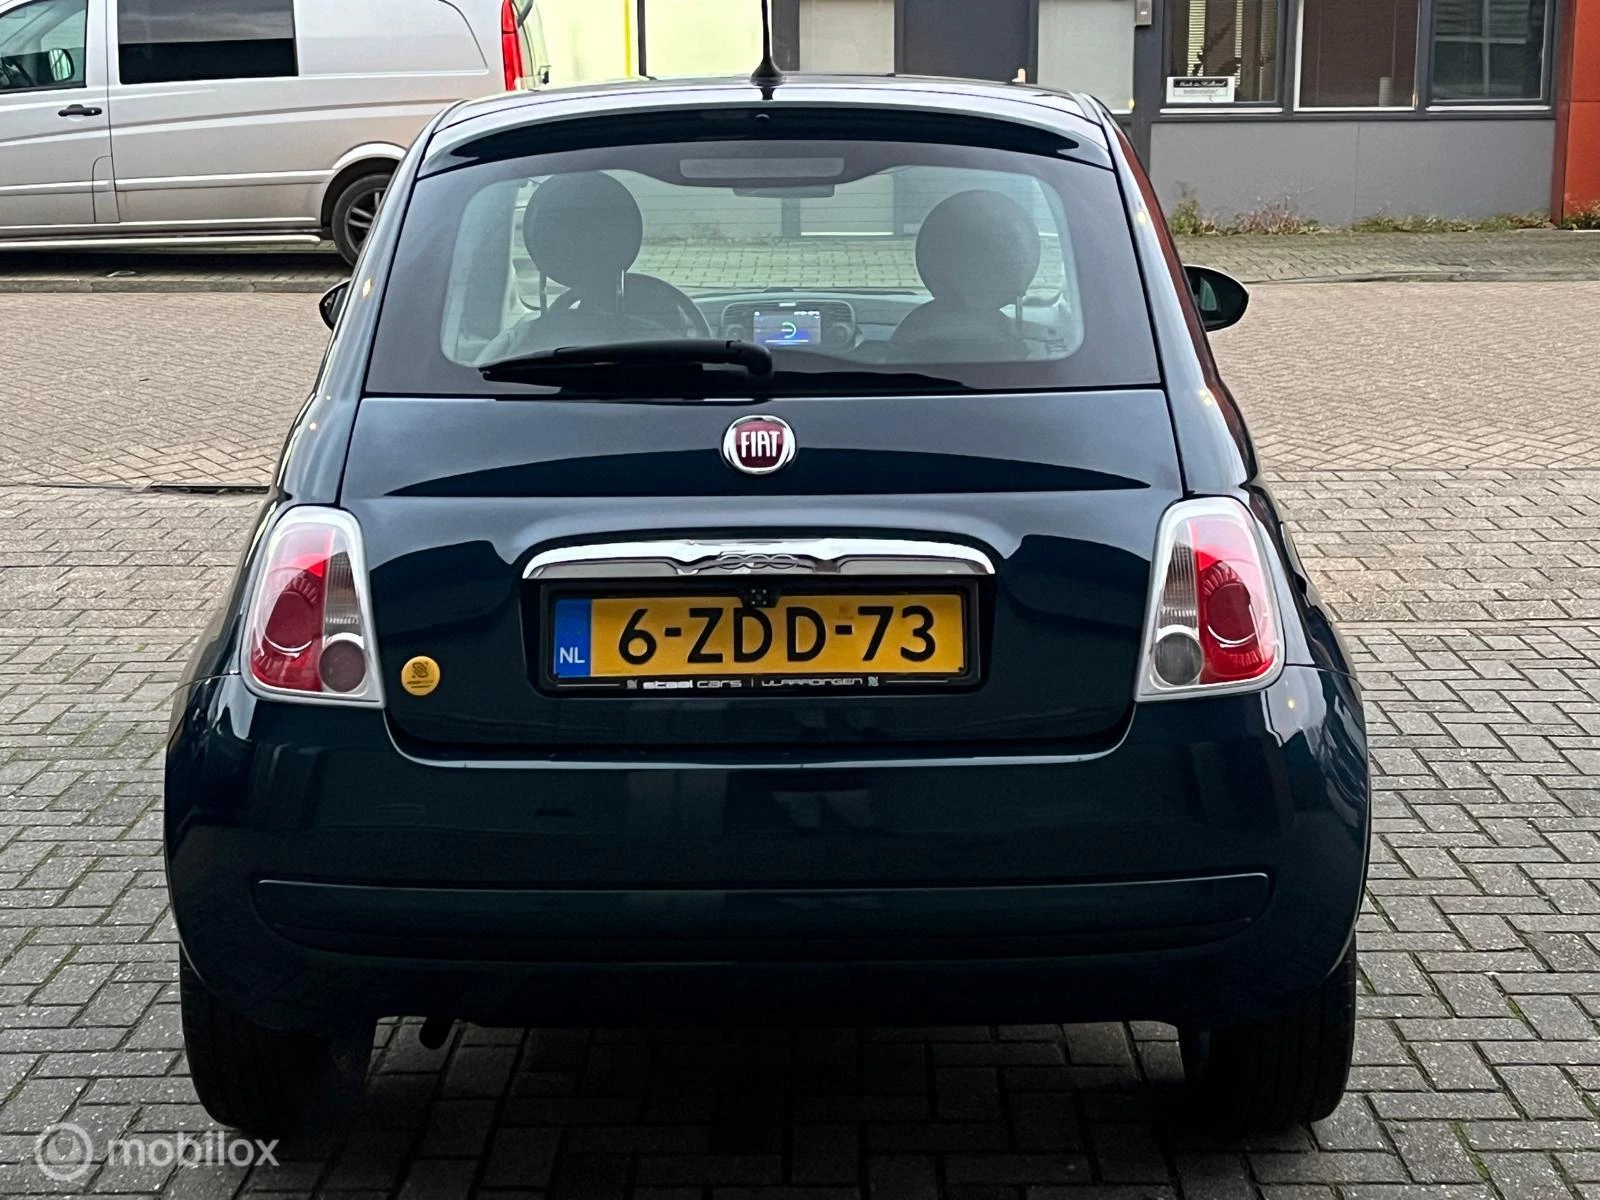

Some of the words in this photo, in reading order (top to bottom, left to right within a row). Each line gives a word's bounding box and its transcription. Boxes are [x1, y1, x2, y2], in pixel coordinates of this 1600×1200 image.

[741, 430, 780, 458] FIAT
[618, 605, 936, 666] 6-ZDD-73
[559, 646, 586, 664] NL
